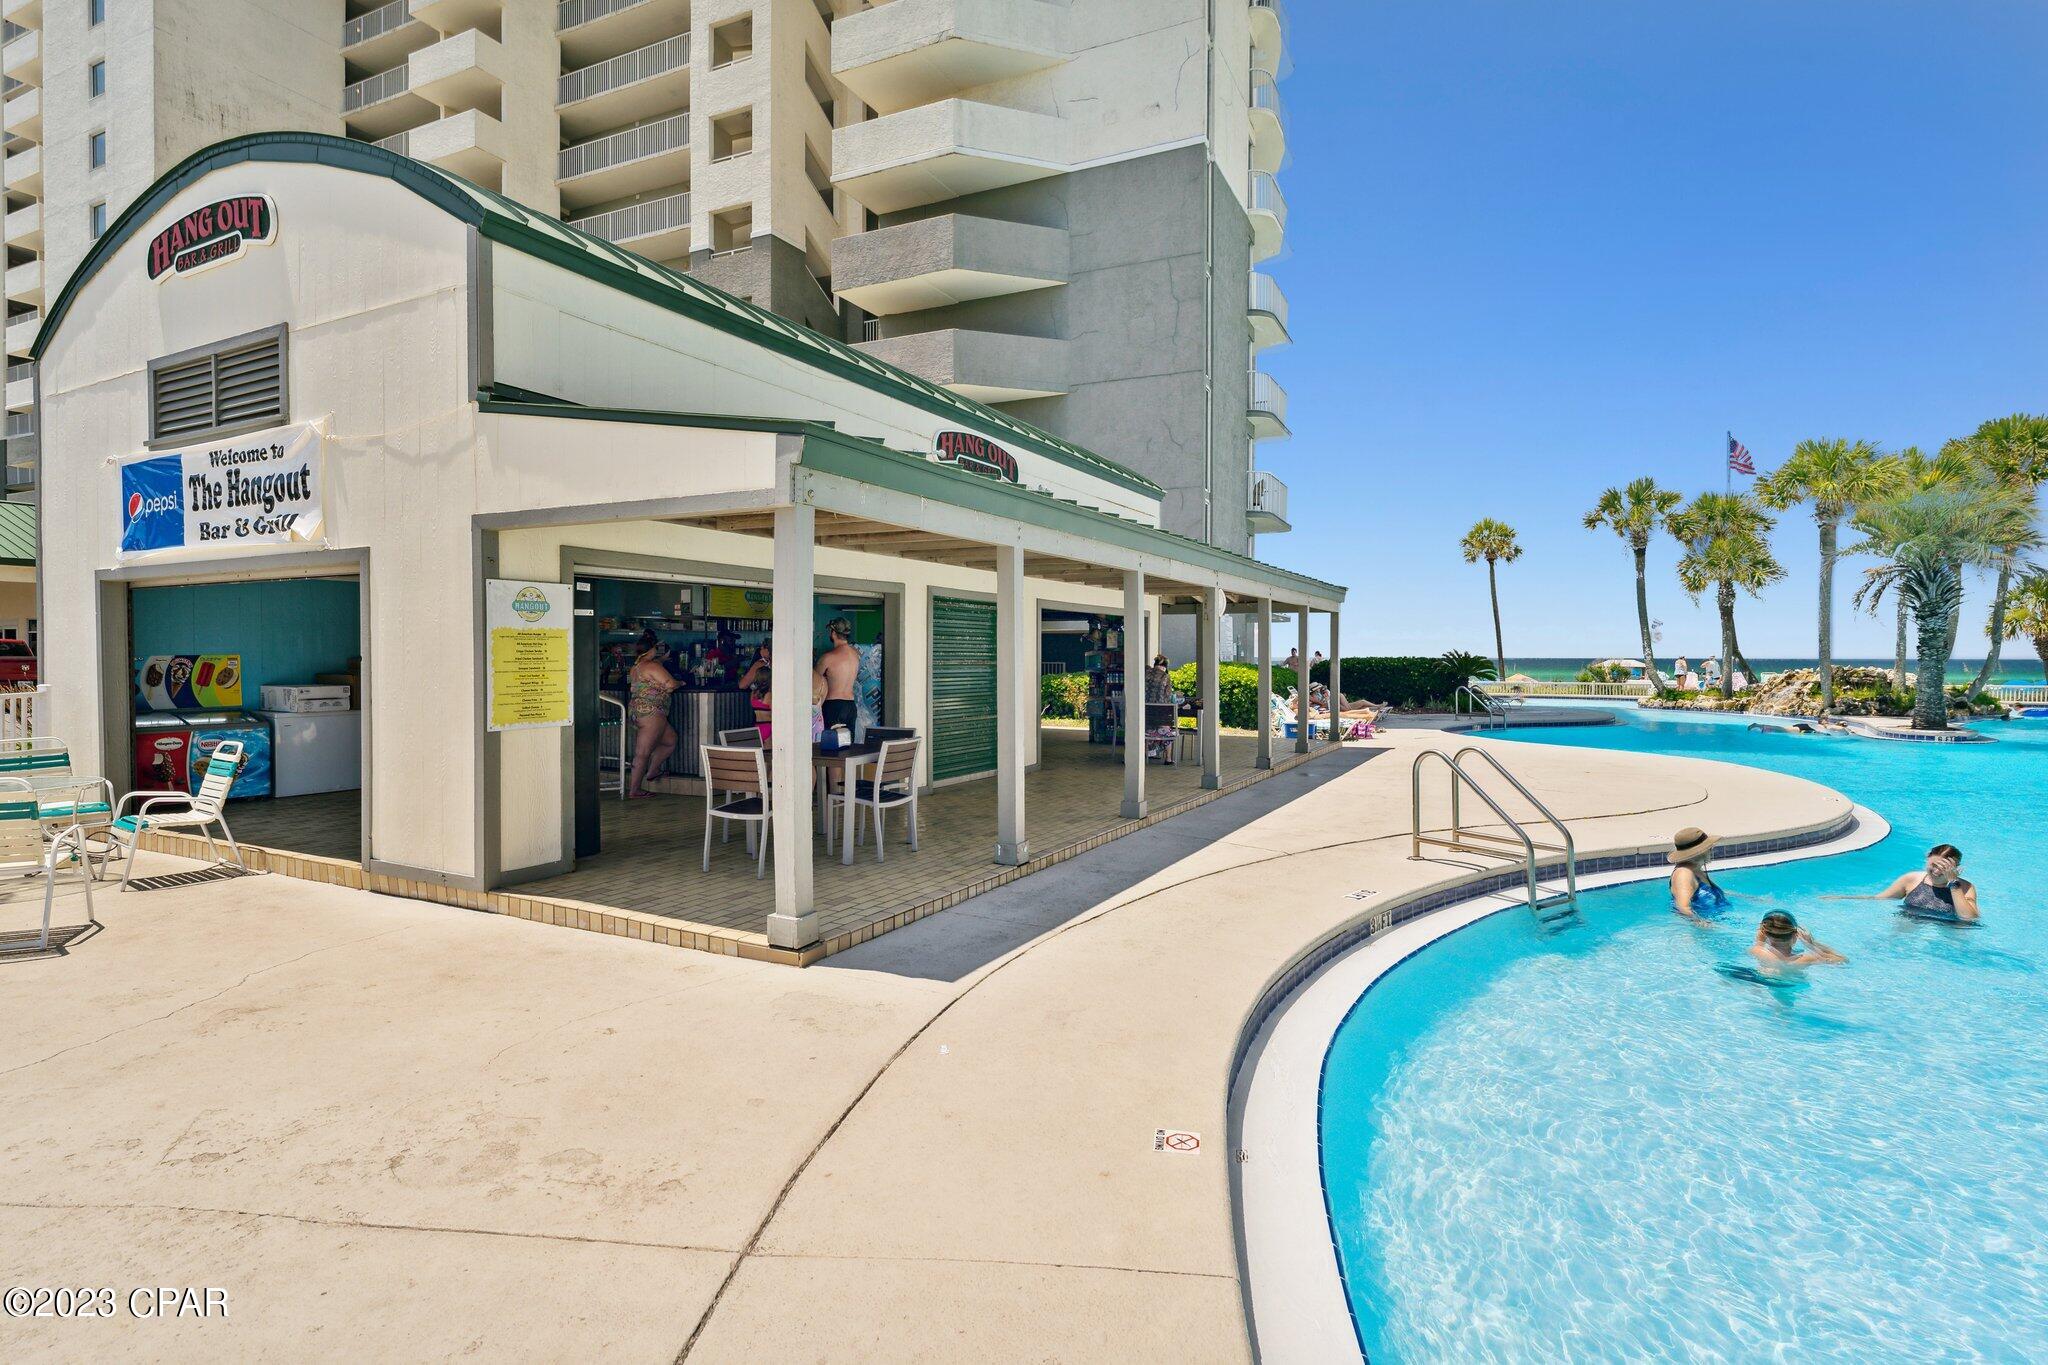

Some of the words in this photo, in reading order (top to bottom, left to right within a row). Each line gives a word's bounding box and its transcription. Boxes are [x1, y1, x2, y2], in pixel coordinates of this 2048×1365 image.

[152, 207, 213, 275] HANG
[217, 198, 264, 238] OUT
[177, 250, 197, 270] BAR
[200, 249, 208, 262] &
[209, 238, 240, 259] GRILL
[209, 448, 268, 467] Welcome
[270, 443, 284, 459] to
[941, 433, 985, 459] HANG
[987, 443, 1016, 481] OUT
[189, 473, 222, 512] The
[226, 463, 311, 514] Hangout
[145, 490, 178, 518] pepsi
[200, 522, 230, 541] Bar
[235, 518, 249, 537] &
[253, 513, 299, 536] Grill
[515, 601, 549, 611] HANGOUT
